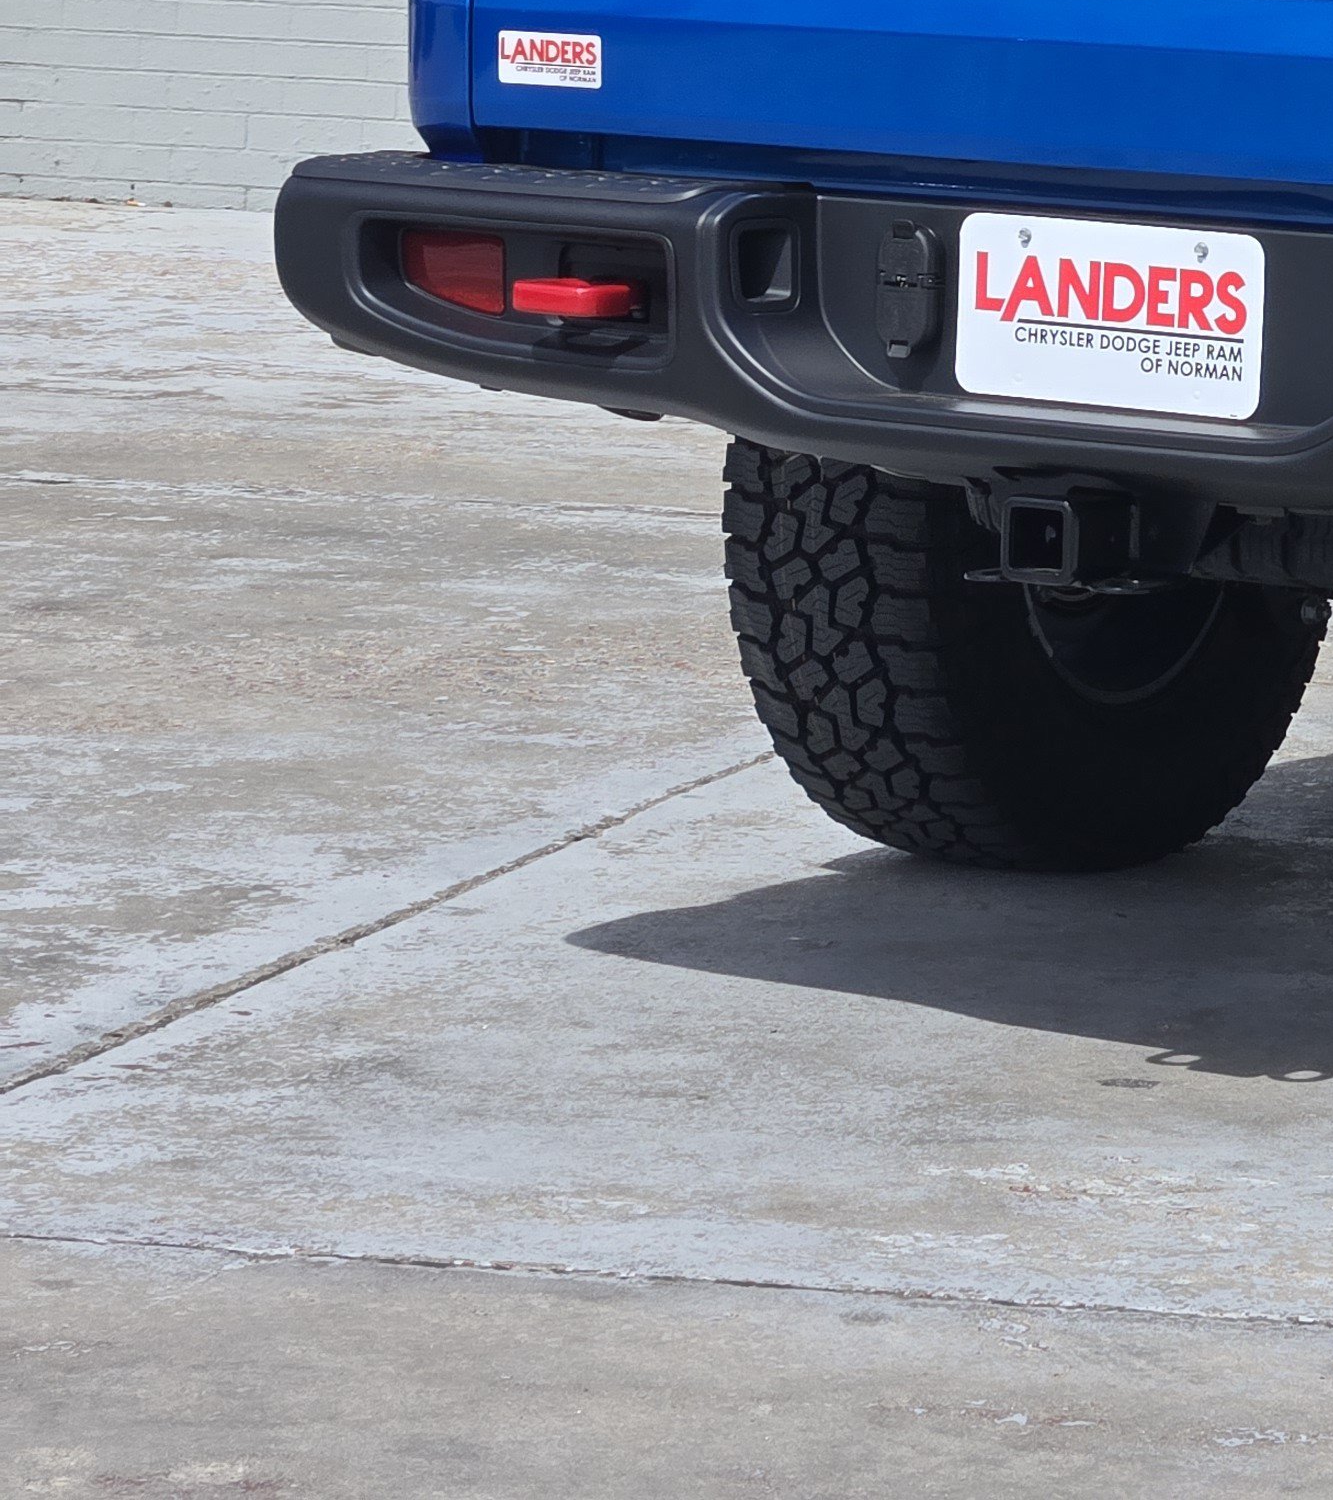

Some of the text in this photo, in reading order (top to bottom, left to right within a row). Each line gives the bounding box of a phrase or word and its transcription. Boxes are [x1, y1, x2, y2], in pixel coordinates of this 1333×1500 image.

[500, 37, 597, 65] LANDERS
[975, 251, 1247, 335] LANDERS
[1014, 327, 1243, 363] CHRYSLER DODGE JEEP RAM
[1140, 357, 1243, 382] OF NORMAN
